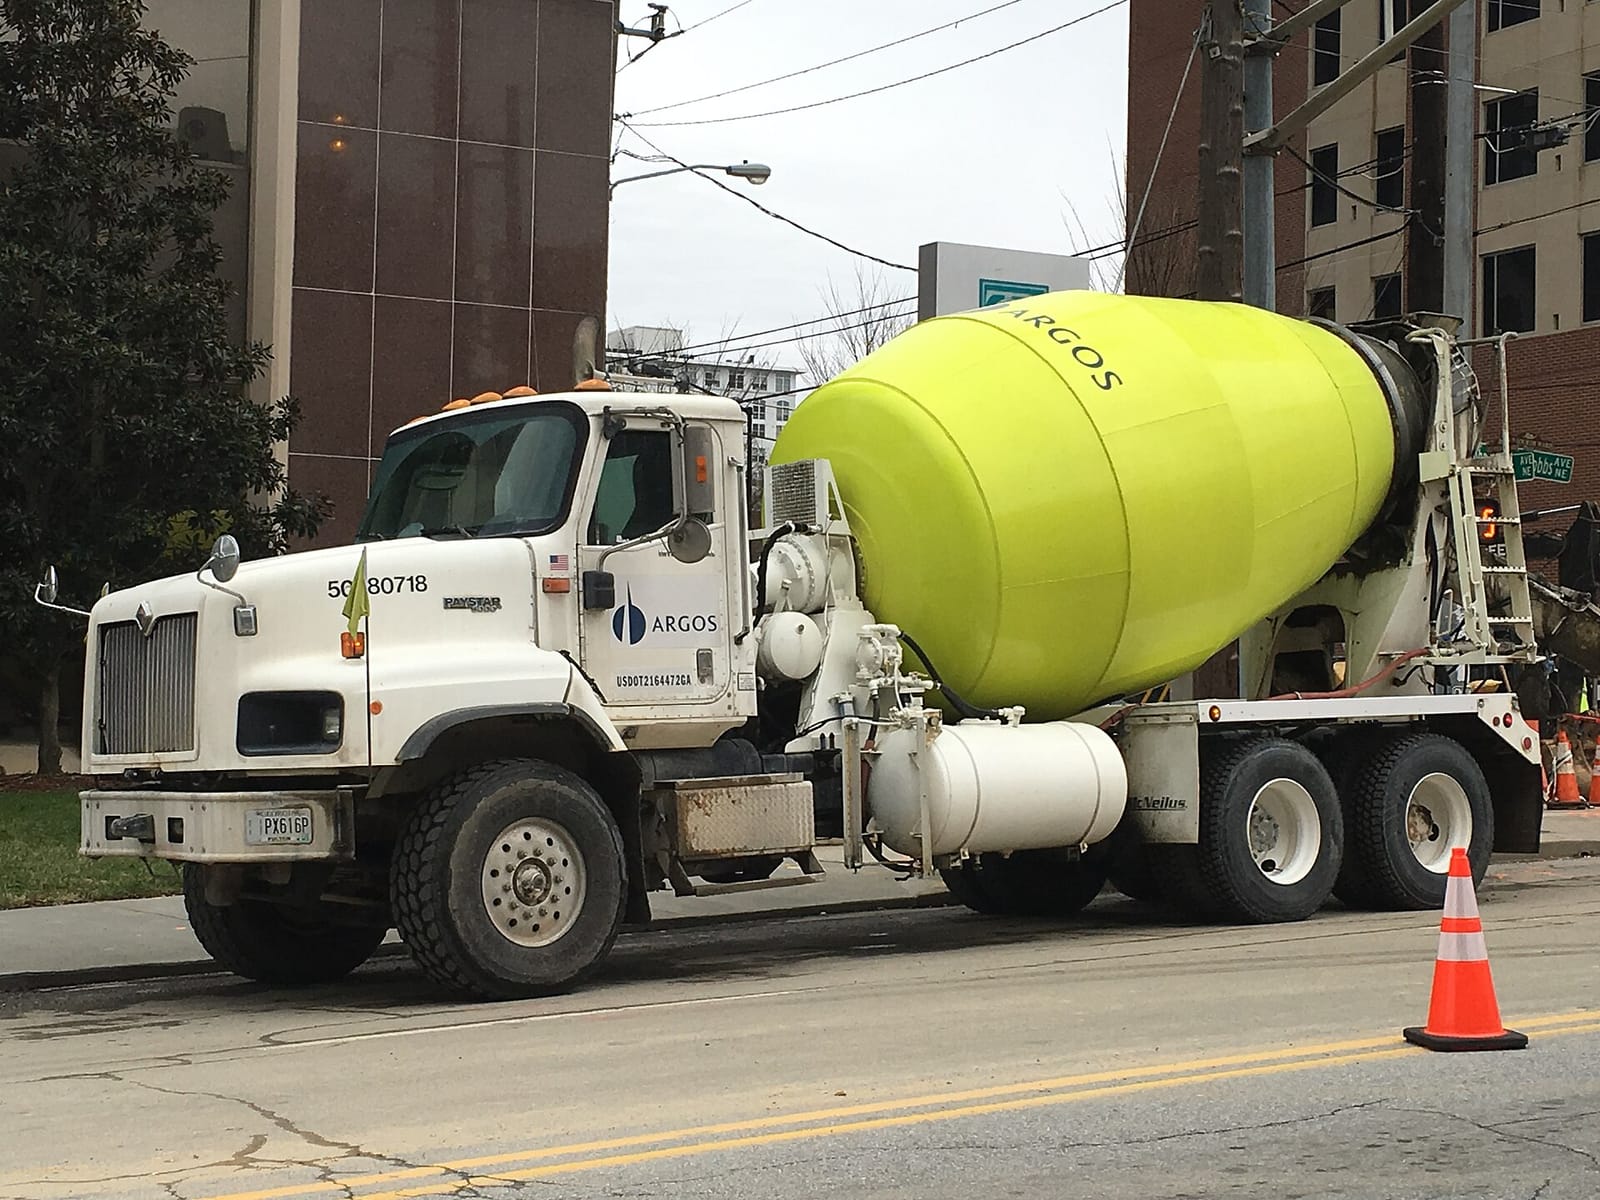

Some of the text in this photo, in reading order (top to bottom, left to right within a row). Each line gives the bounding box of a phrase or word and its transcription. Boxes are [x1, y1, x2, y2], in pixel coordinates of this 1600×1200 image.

[998, 309, 1123, 391] ARGOS
[1553, 457, 1572, 469] AVE
[1554, 468, 1568, 479] NE
[327, 575, 428, 598] 5080718
[443, 597, 502, 610] PAYSTAR
[652, 615, 717, 632] ARGOS
[616, 674, 691, 687] USDOT2164472GA
[265, 817, 309, 835] PX616P
